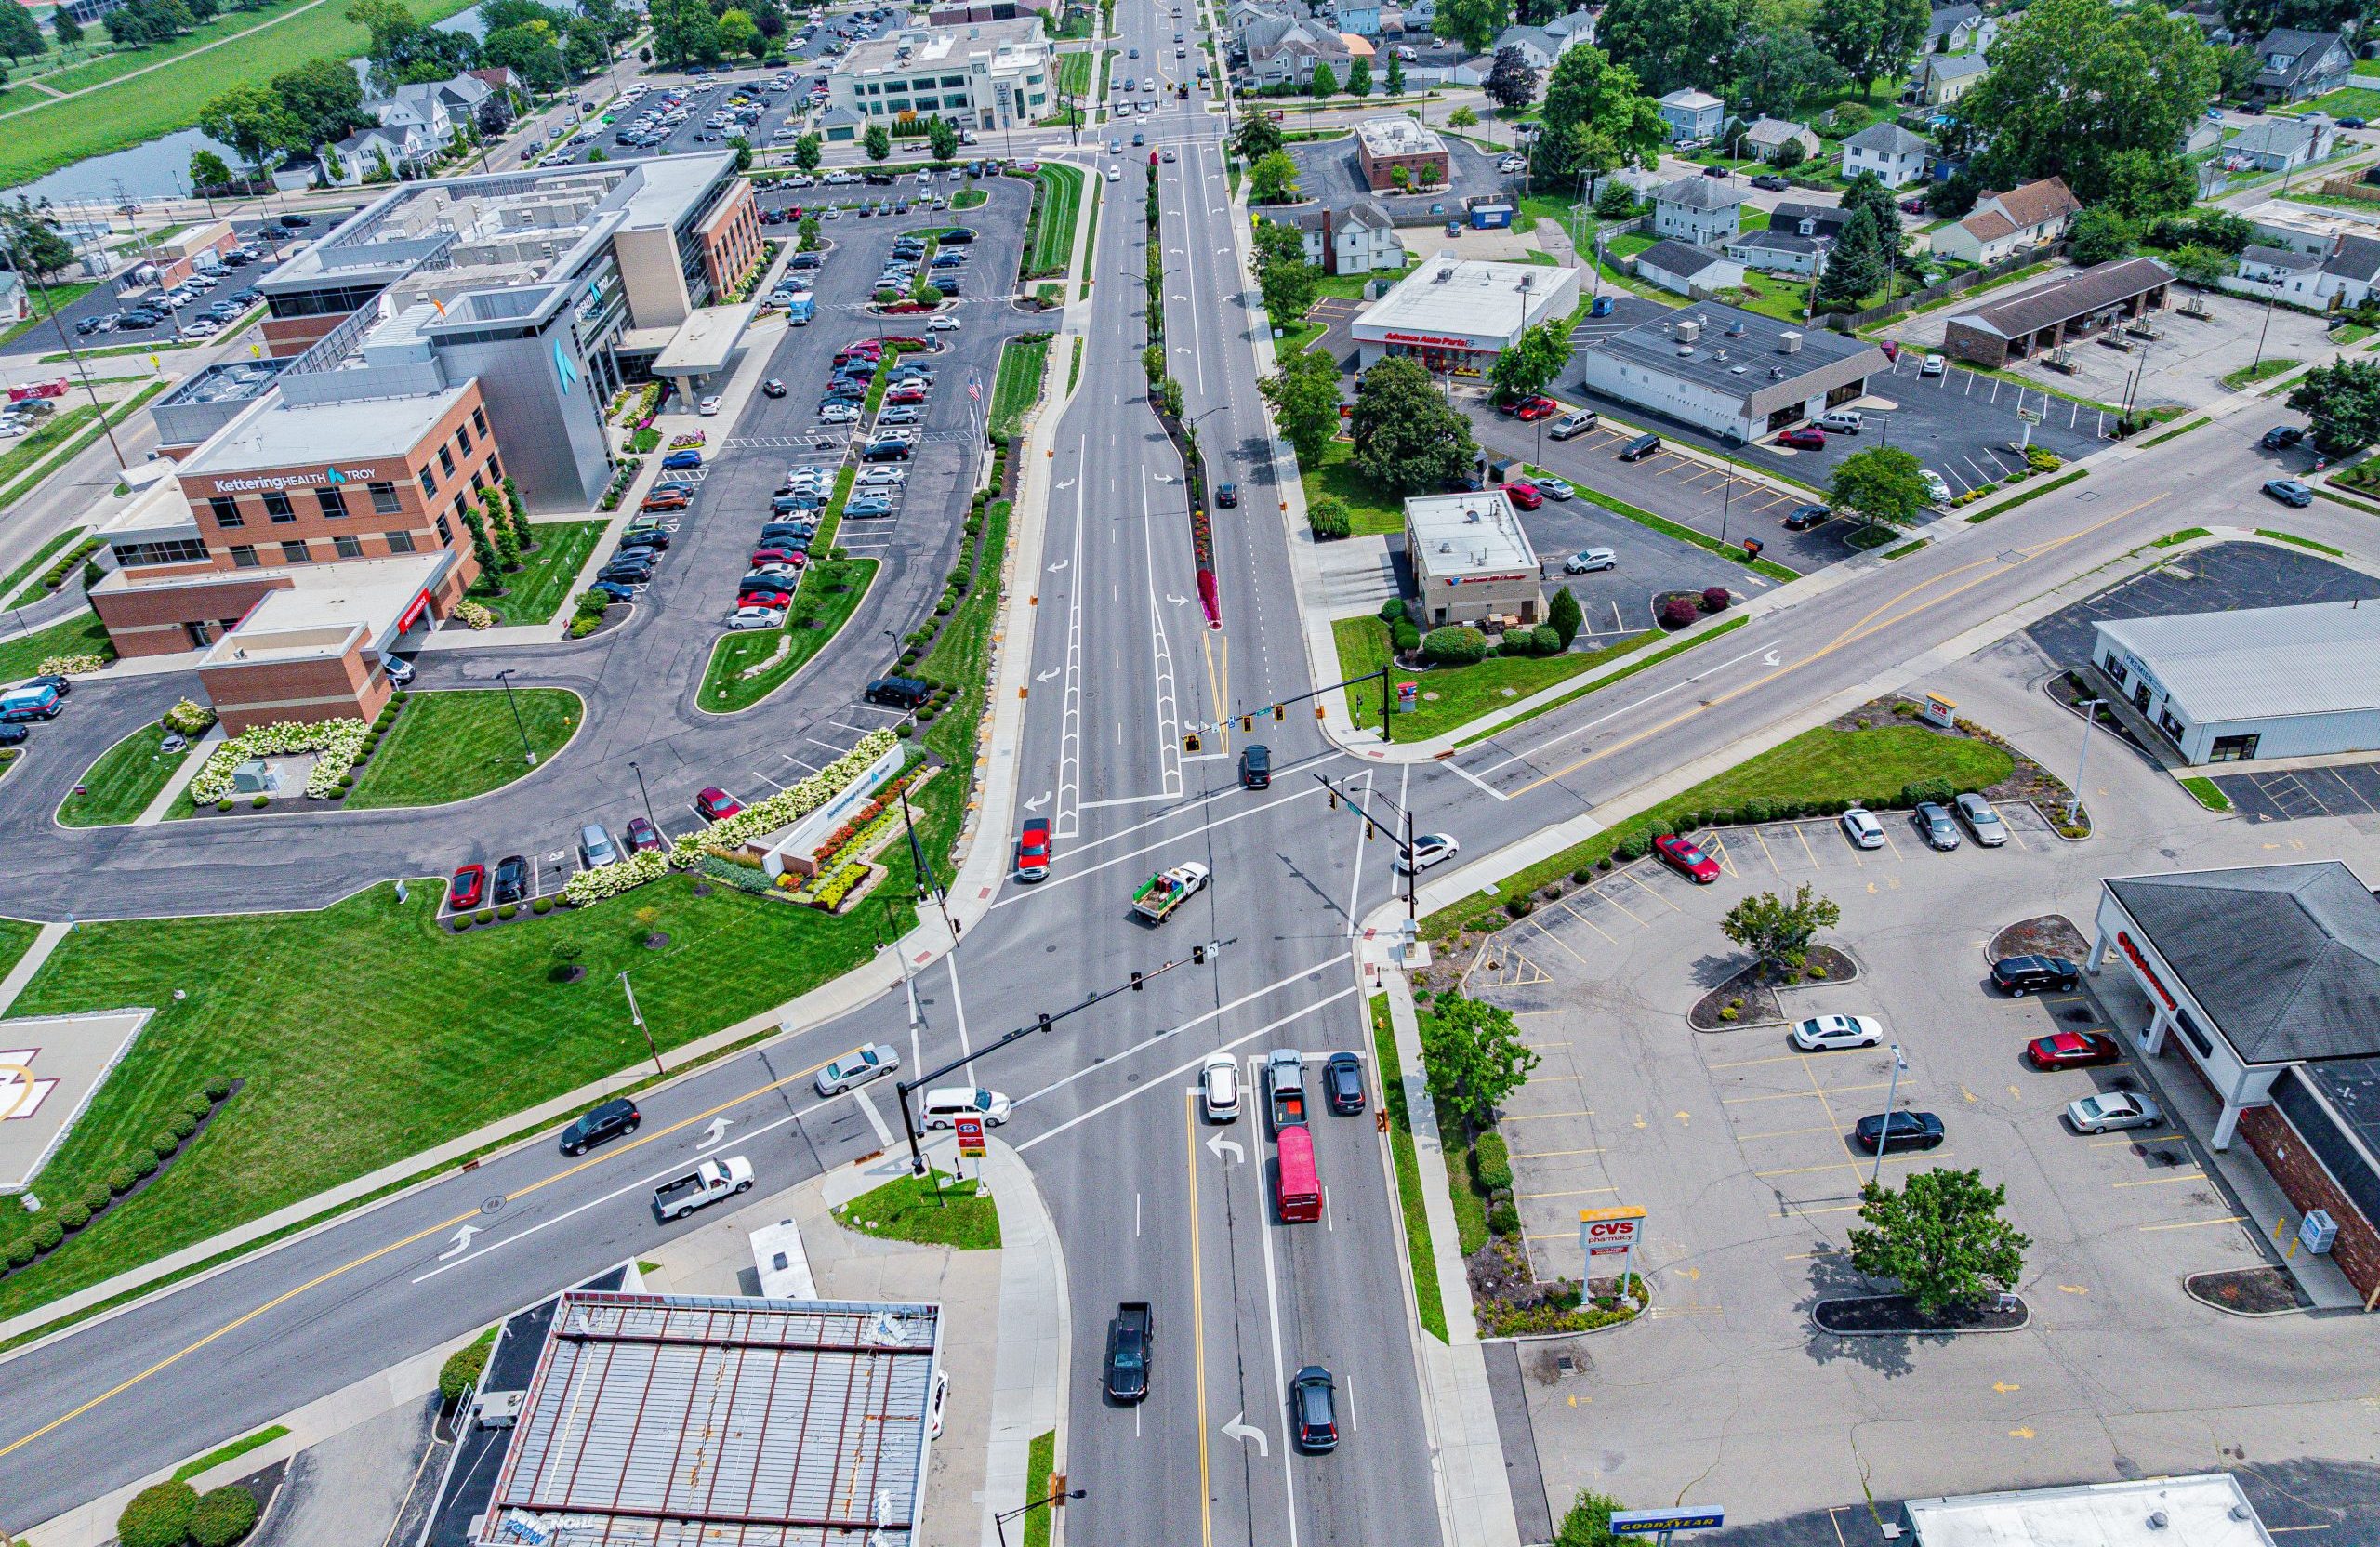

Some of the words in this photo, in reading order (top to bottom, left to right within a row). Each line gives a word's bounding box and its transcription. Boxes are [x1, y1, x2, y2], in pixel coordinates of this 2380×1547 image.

[1385, 332, 1420, 342] Advance
[1420, 336, 1441, 345] Auto
[1442, 337, 1466, 347] Parts
[345, 469, 376, 481] TROY
[404, 595, 427, 626] AMBULANCE
[2126, 654, 2152, 681] PREMIER
[1931, 703, 1948, 715] CVS
[1591, 1222, 1633, 1236] CVS
[1588, 1235, 1633, 1244] pharmacy
[1620, 1518, 1714, 1530] GOODYEAR
